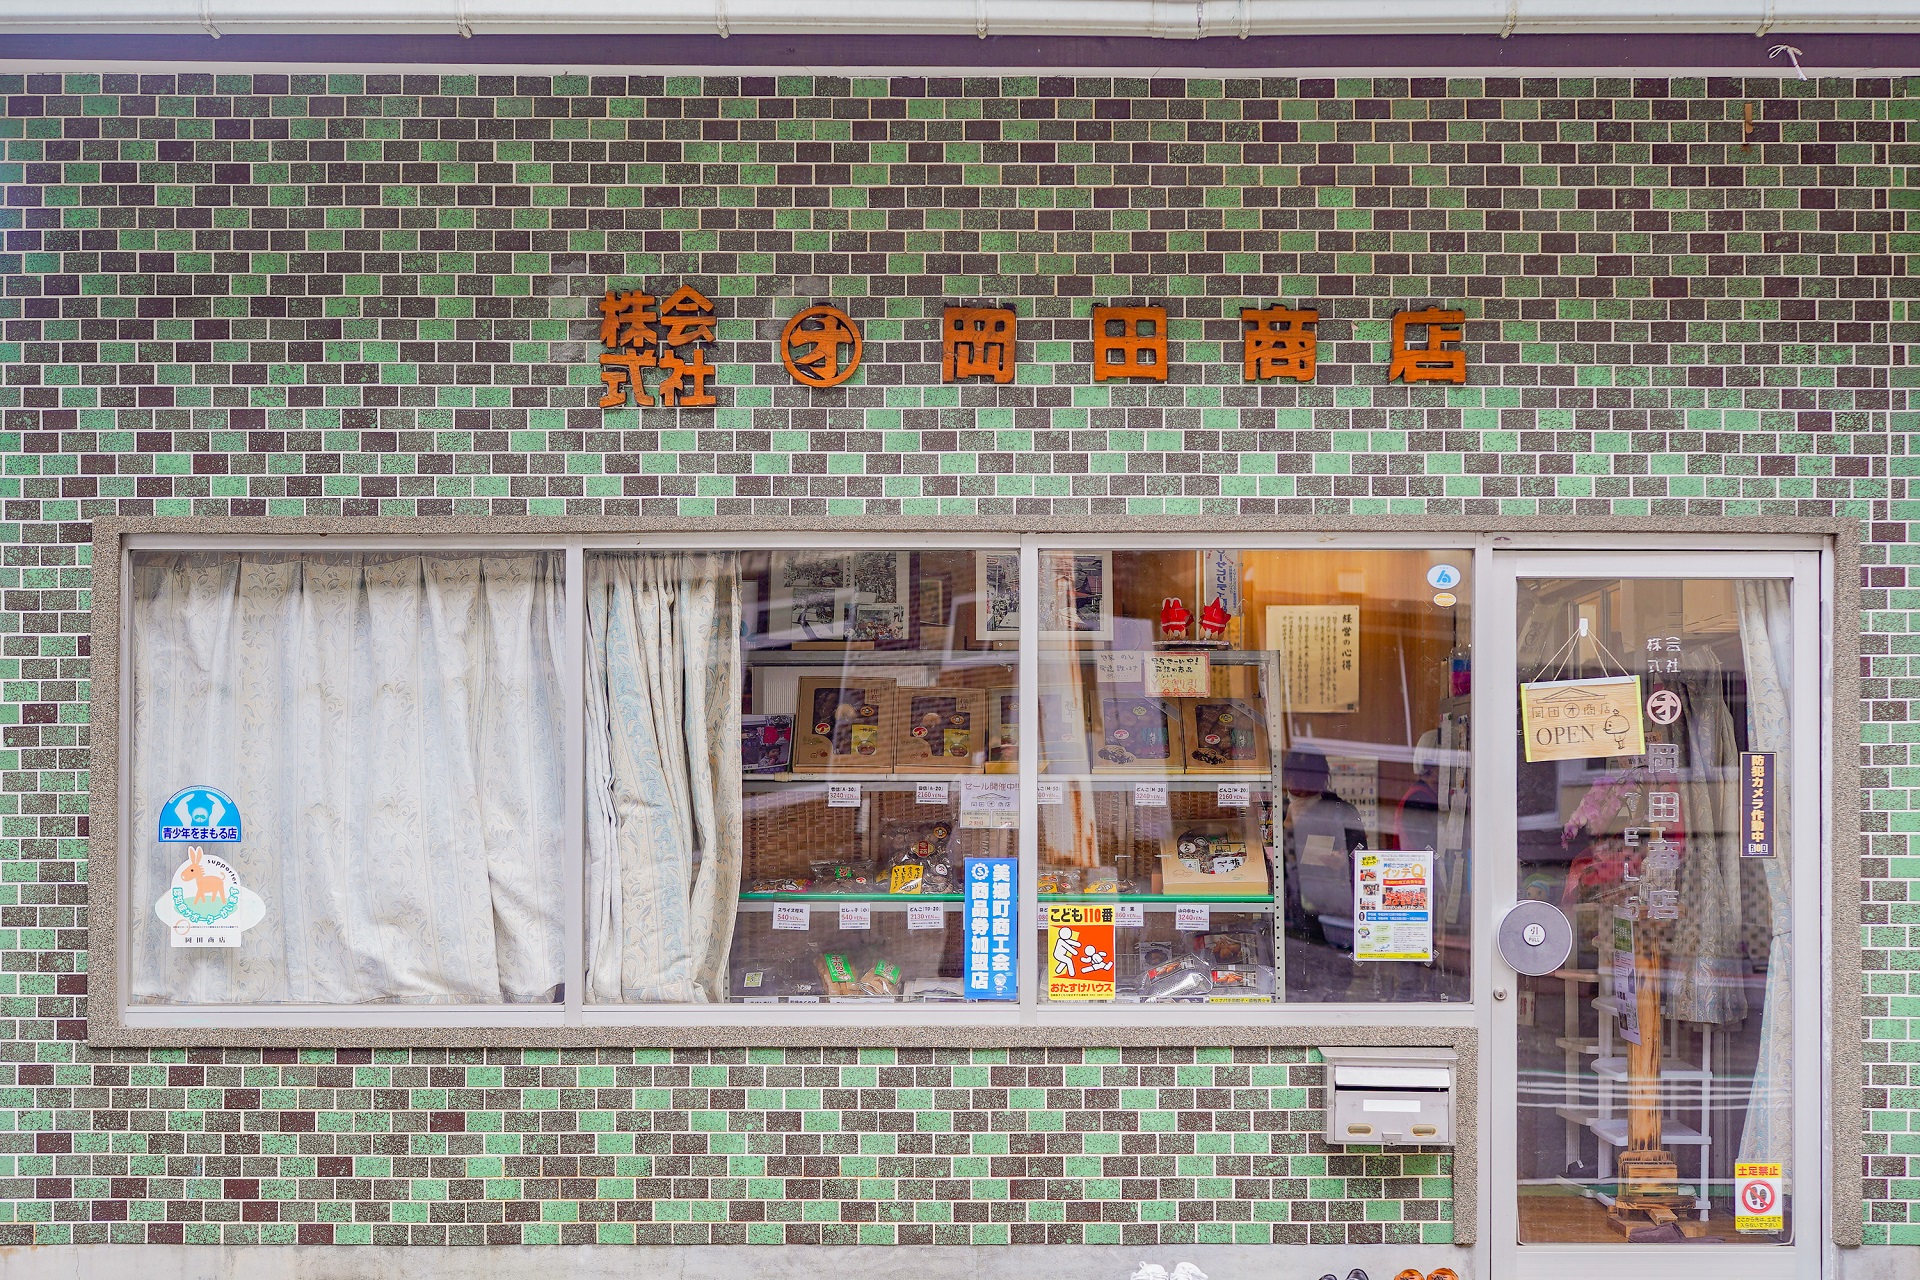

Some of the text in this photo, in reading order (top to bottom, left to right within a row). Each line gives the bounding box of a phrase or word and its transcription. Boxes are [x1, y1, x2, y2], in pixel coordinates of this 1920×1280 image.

[943, 305, 1467, 384] 岡田商店
[1536, 724, 1596, 746] OPEN
[1750, 755, 1765, 843] 防犯カメラ作動中
[163, 827, 238, 840] 青少年をまもる店
[207, 858, 238, 885] supporter
[992, 863, 1011, 972] 美郷町商工会
[1050, 907, 1113, 923] こども110番
[971, 882, 990, 990] 商品券加盟店
[1050, 983, 1113, 993] おたすけハウス
[1738, 1166, 1779, 1176] 土足禁止
